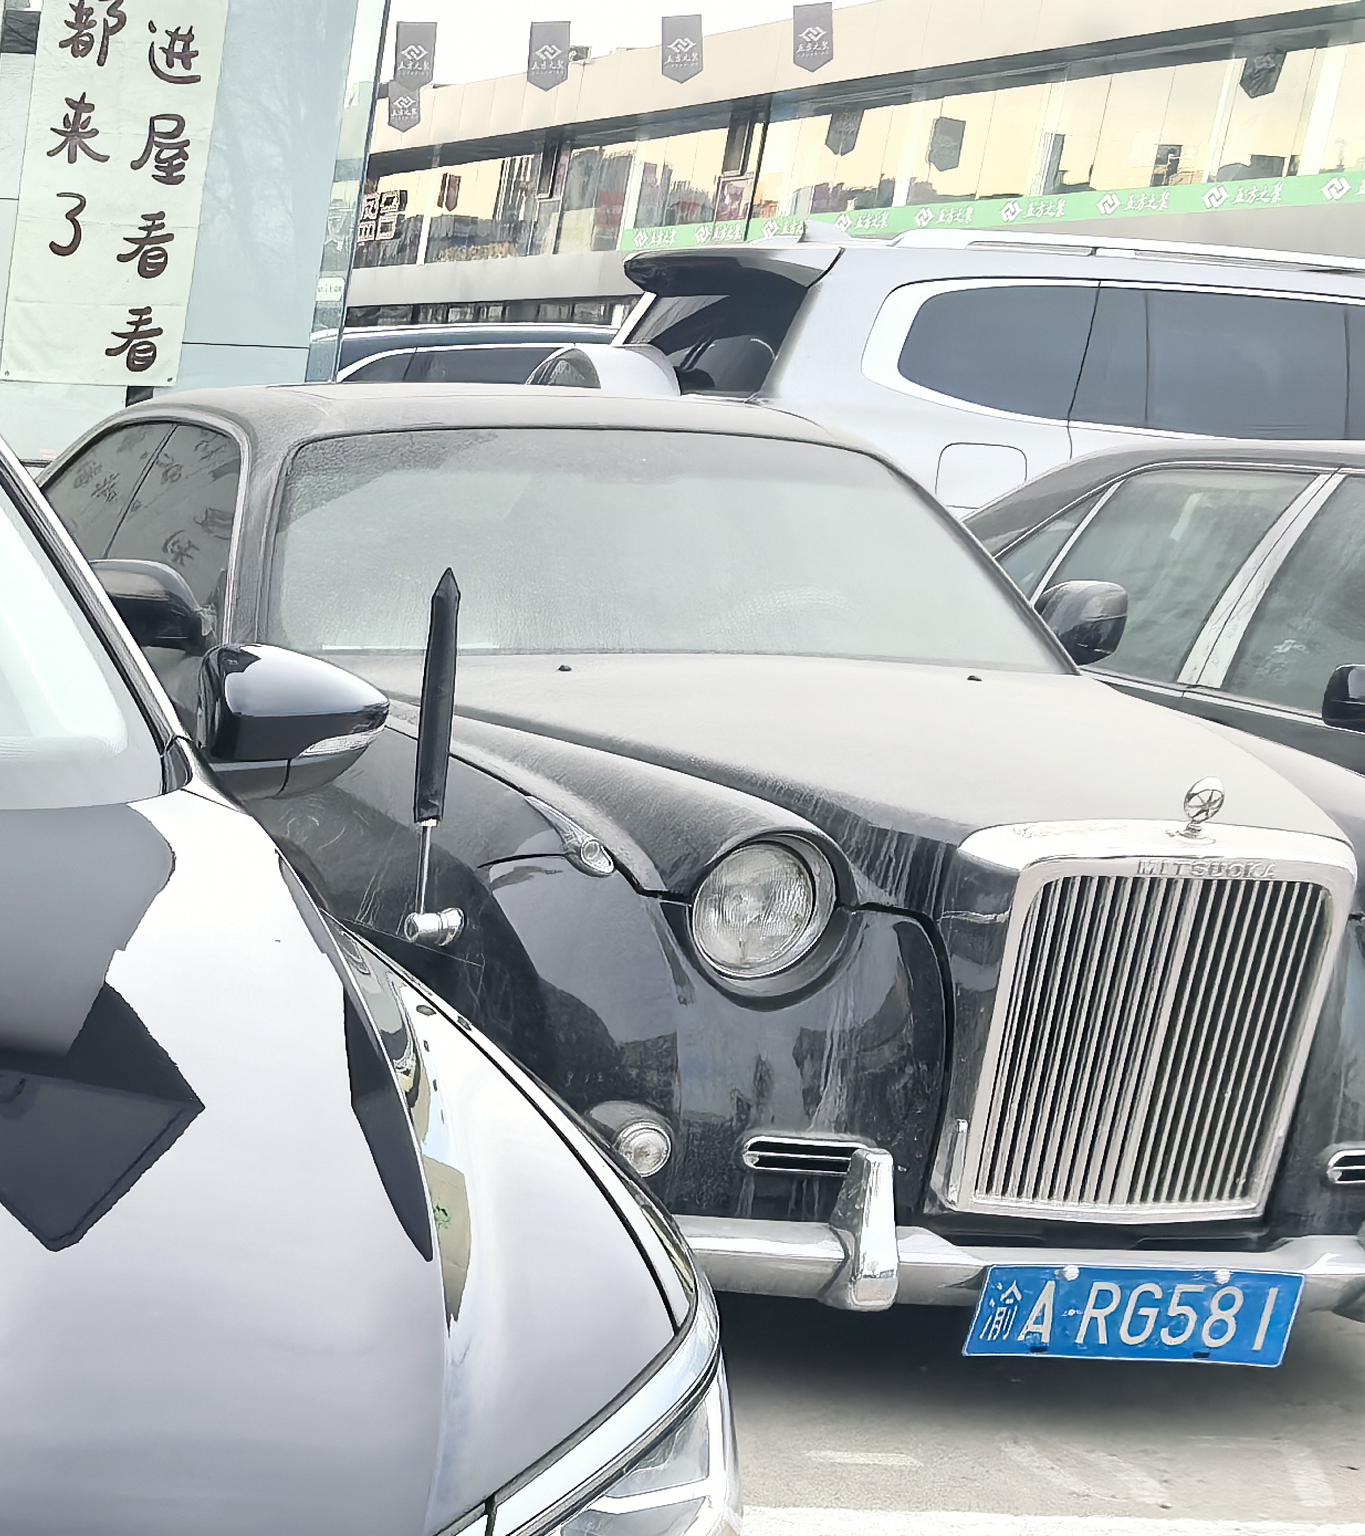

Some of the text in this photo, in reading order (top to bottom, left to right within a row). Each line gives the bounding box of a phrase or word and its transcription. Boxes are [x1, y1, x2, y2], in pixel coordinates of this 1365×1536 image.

[46, 0, 128, 257] 都来了
[105, 20, 201, 373] 进屋看看
[1137, 858, 1276, 880] MITSUOKA
